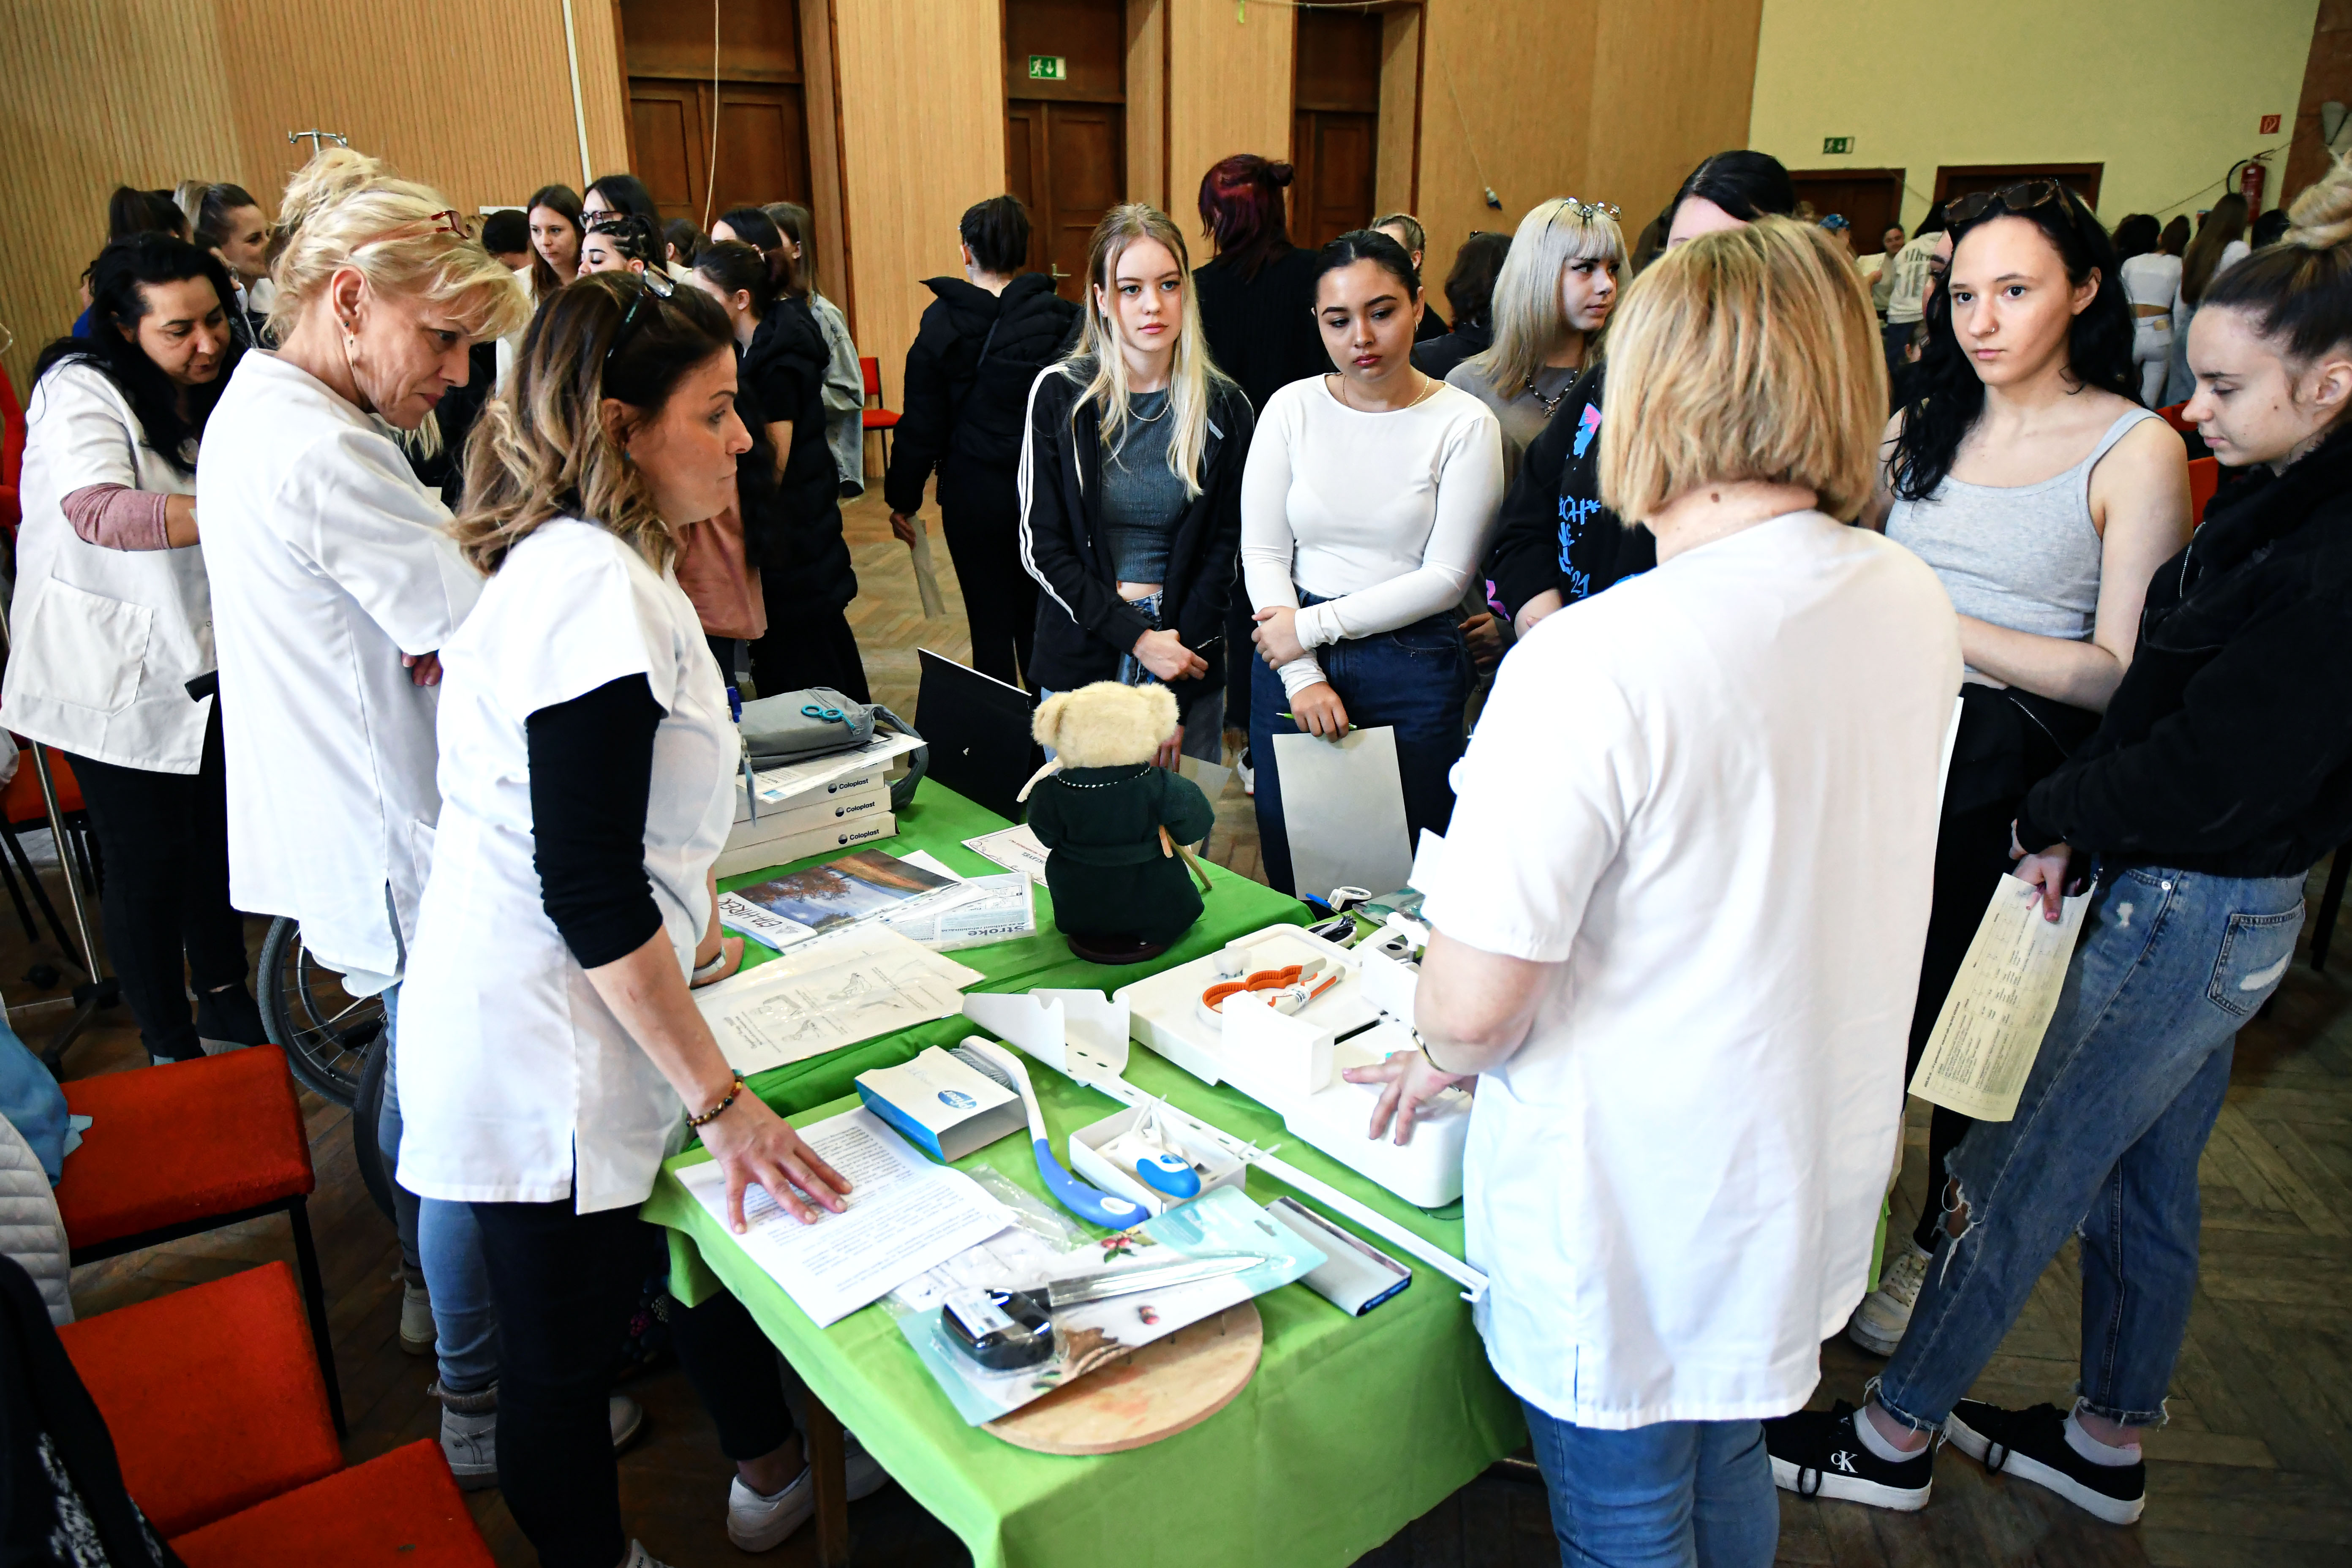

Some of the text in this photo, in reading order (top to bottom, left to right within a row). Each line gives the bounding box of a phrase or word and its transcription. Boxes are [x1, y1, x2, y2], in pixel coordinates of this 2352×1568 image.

[839, 779, 868, 789] Coloplast
[846, 801, 875, 812] Coloplast
[849, 829, 879, 840] Coloplast
[968, 926, 1024, 936] Stroke
